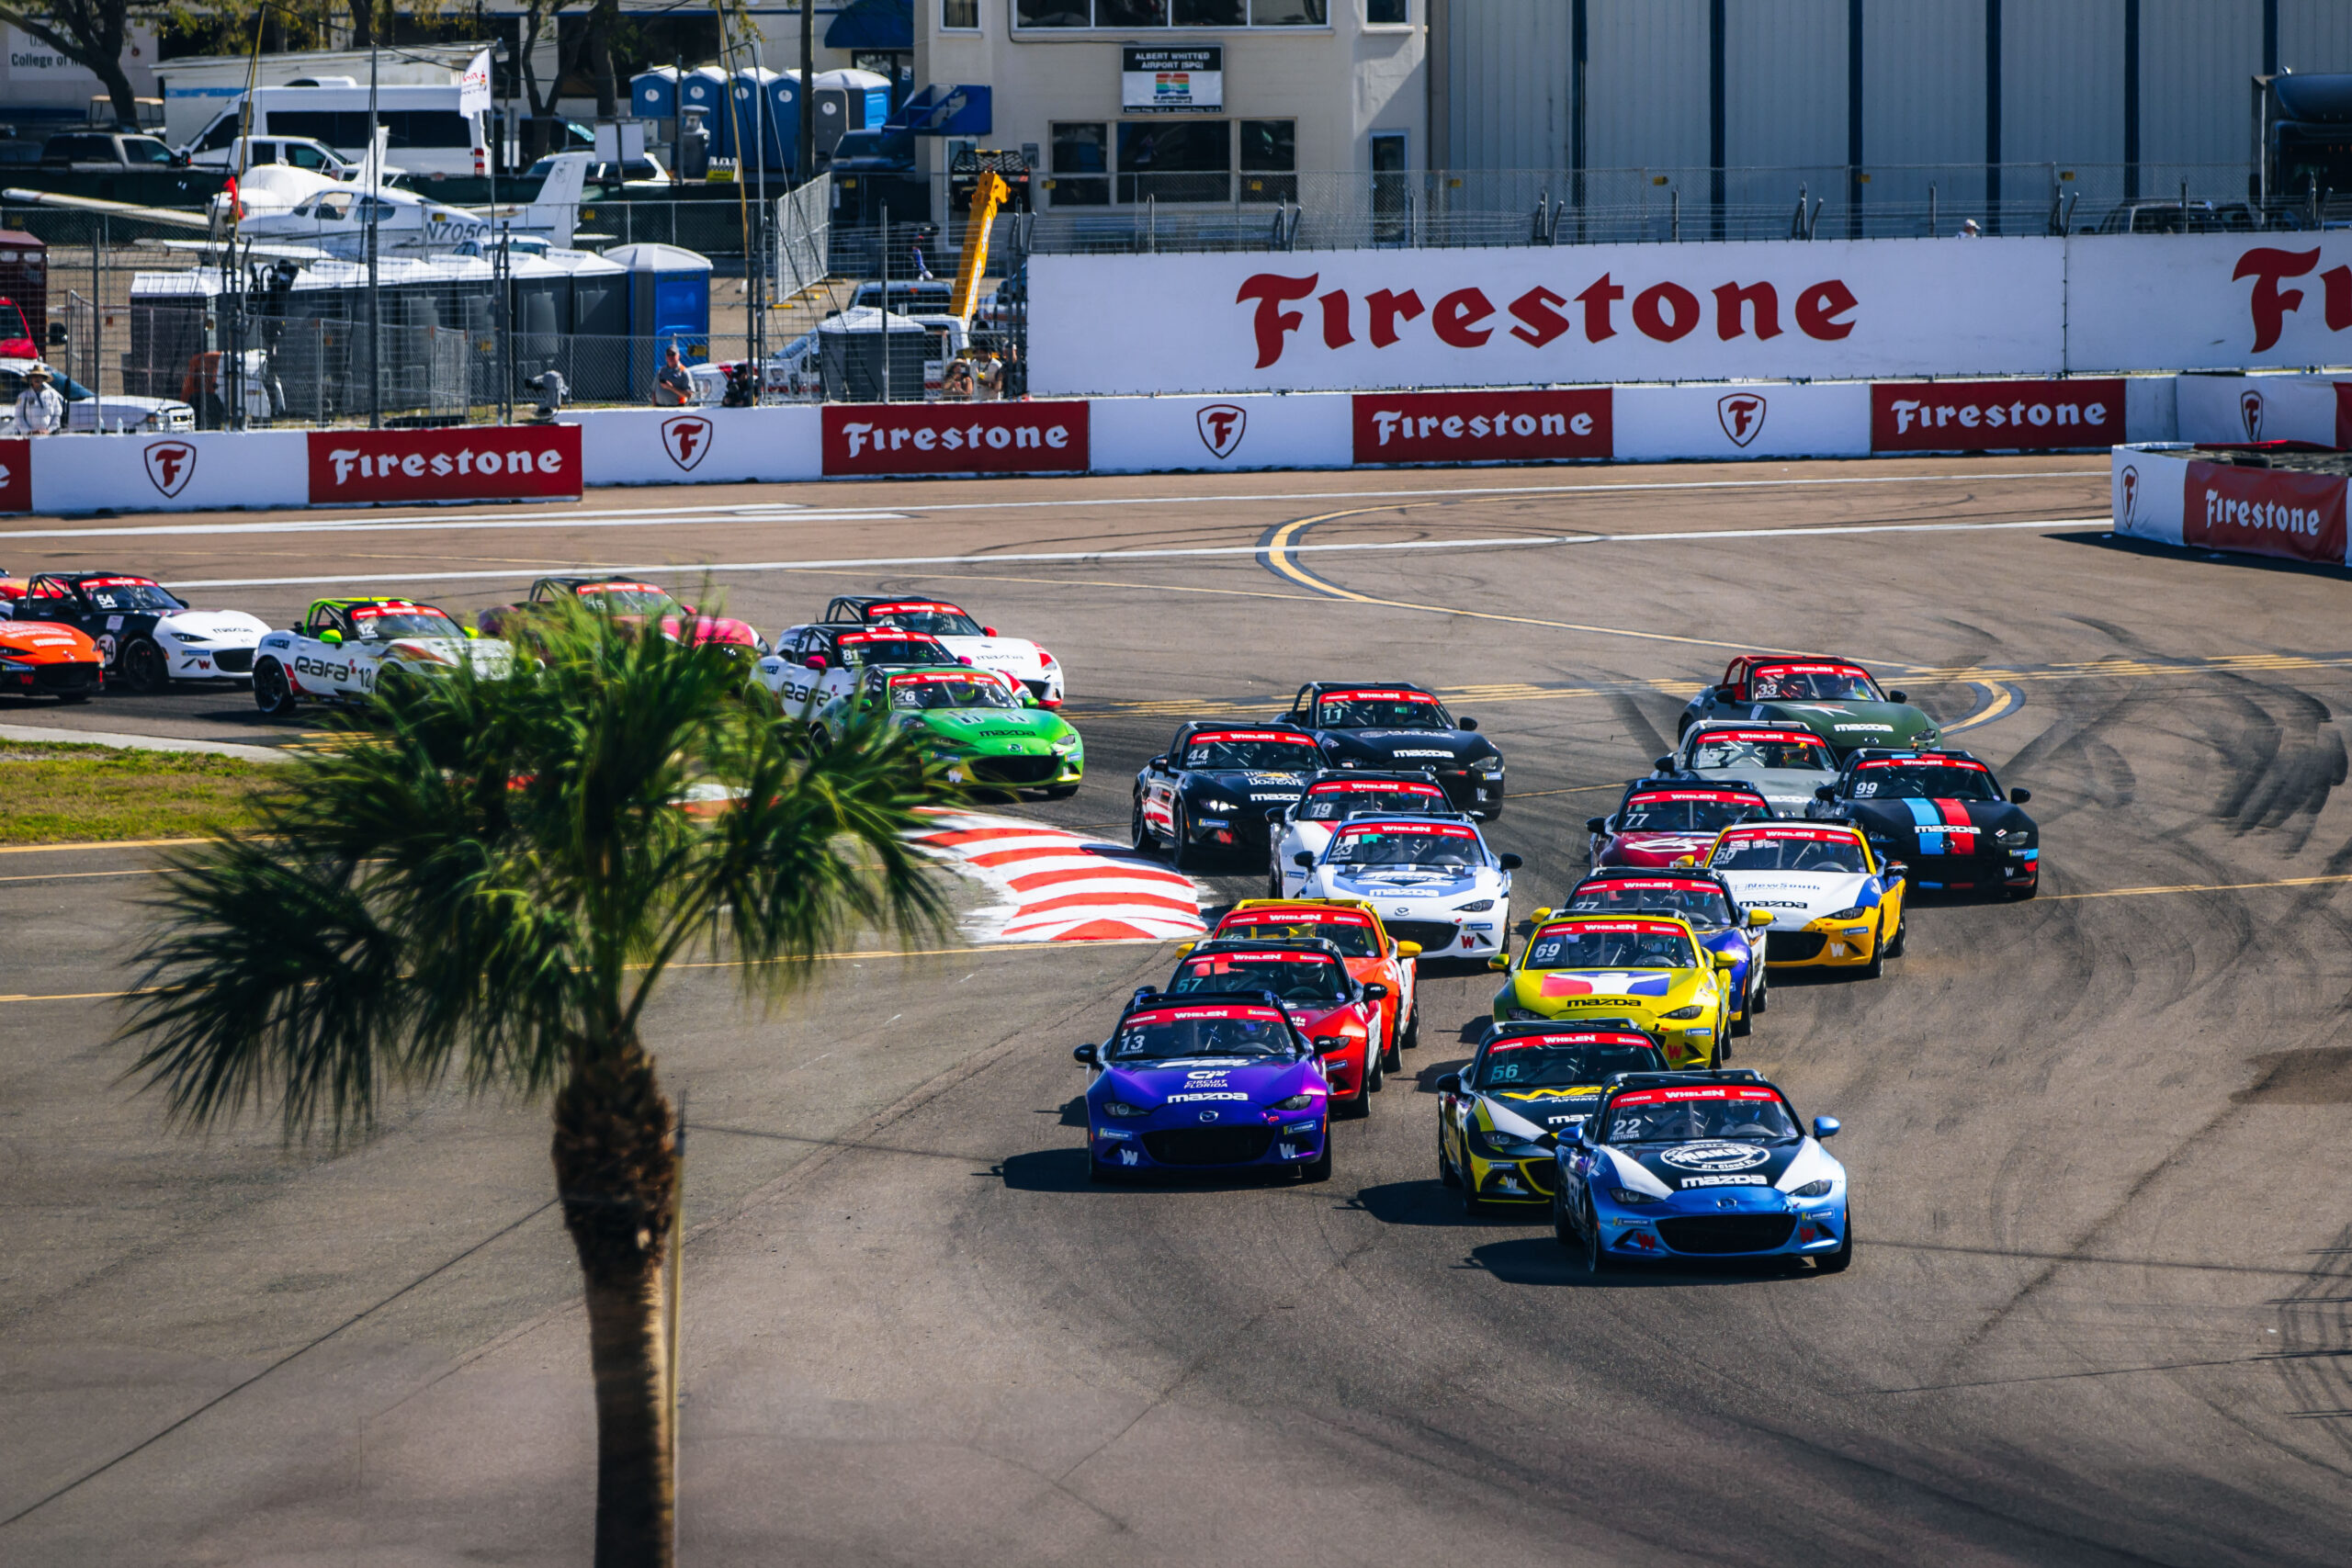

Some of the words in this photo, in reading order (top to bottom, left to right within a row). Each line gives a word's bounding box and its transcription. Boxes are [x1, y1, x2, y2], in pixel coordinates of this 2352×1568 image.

[11, 53, 52, 69] College
[1135, 52, 1169, 61] ALBERT
[1170, 51, 1210, 60] WHITTED
[1141, 62, 1179, 70] AIRPORT
[1236, 272, 1859, 369] Firestone
[1891, 399, 2107, 435] Firestone
[1372, 410, 1594, 446] Firestone
[842, 422, 1069, 458] Firestone
[329, 447, 562, 486] Firestone
[2205, 489, 2321, 536] Firestone
[96, 593, 116, 606] 54
[357, 624, 377, 636] 12
[99, 638, 114, 660] 54
[842, 648, 860, 661] 81
[976, 653, 1024, 661] mazda
[1792, 665, 1834, 673] WHELEN
[358, 667, 372, 689] 12
[1758, 683, 1779, 696] 33
[895, 690, 916, 703] 26
[1323, 708, 1342, 720] 11
[979, 729, 1035, 738] mazda
[1833, 723, 1894, 733] mazda
[1187, 749, 1210, 761] 44
[1393, 749, 1455, 759] mazda
[1351, 783, 1399, 791] WHELEN
[1855, 782, 1879, 795] 99
[1250, 793, 1302, 802] mazd
[1312, 802, 1332, 817] 19
[1624, 813, 1650, 827] 77
[1766, 830, 1815, 839] WHELEN
[1914, 825, 1982, 835] mazda
[1331, 842, 1354, 856] 23
[1623, 881, 1674, 889] WHELEN
[1747, 882, 1821, 891] NewSouth
[1369, 887, 1440, 897] mazda
[1739, 900, 1808, 909] mazda
[1269, 913, 1322, 921] WHELEN
[1584, 923, 1638, 931] WHELEN
[1233, 953, 1283, 961] WHELEN
[1534, 942, 1561, 959] 69
[1177, 977, 1204, 993] 57
[1566, 998, 1642, 1008] mazda
[1174, 1010, 1229, 1020] WHELEN
[1120, 1034, 1147, 1053] 13
[1493, 1042, 1524, 1051] mazda
[1543, 1034, 1597, 1043] WHELEN
[1492, 1064, 1519, 1081] 56
[1167, 1091, 1250, 1104] mazda
[1621, 1095, 1652, 1103] mazda
[1665, 1089, 1727, 1100] WHELEN
[1612, 1118, 1643, 1136] 22
[1680, 1174, 1768, 1190] mazda
